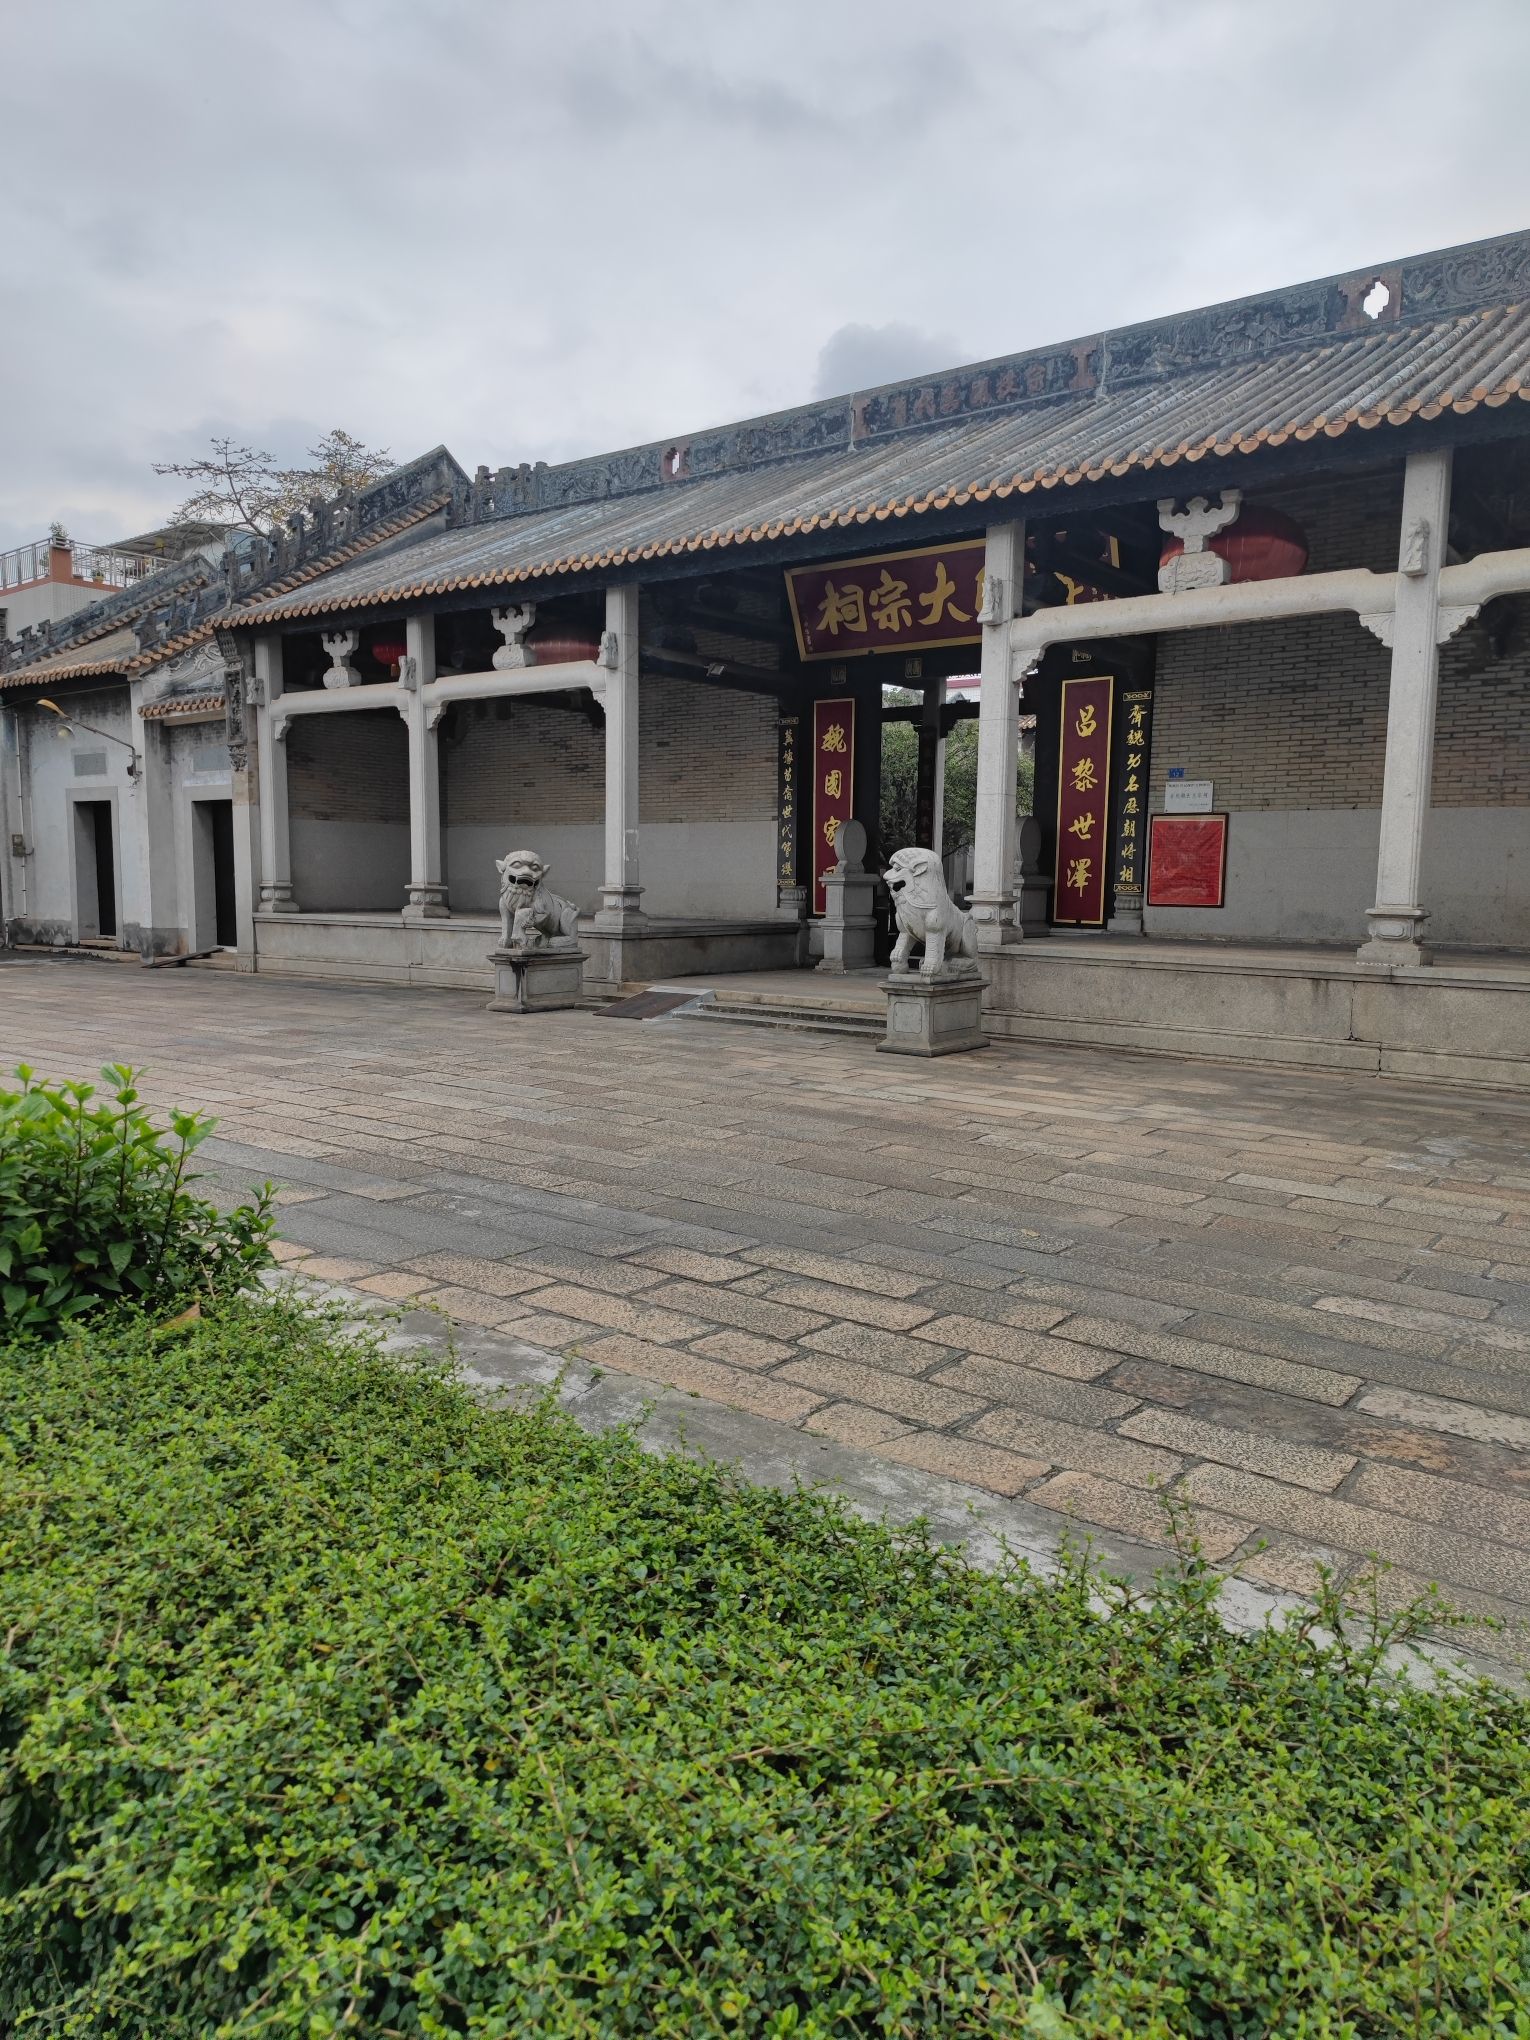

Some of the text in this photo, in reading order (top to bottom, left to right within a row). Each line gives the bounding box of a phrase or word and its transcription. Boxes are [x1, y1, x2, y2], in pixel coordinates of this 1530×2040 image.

[820, 722, 847, 888] 魏國家
[1066, 704, 1099, 898] 昌黎世澤
